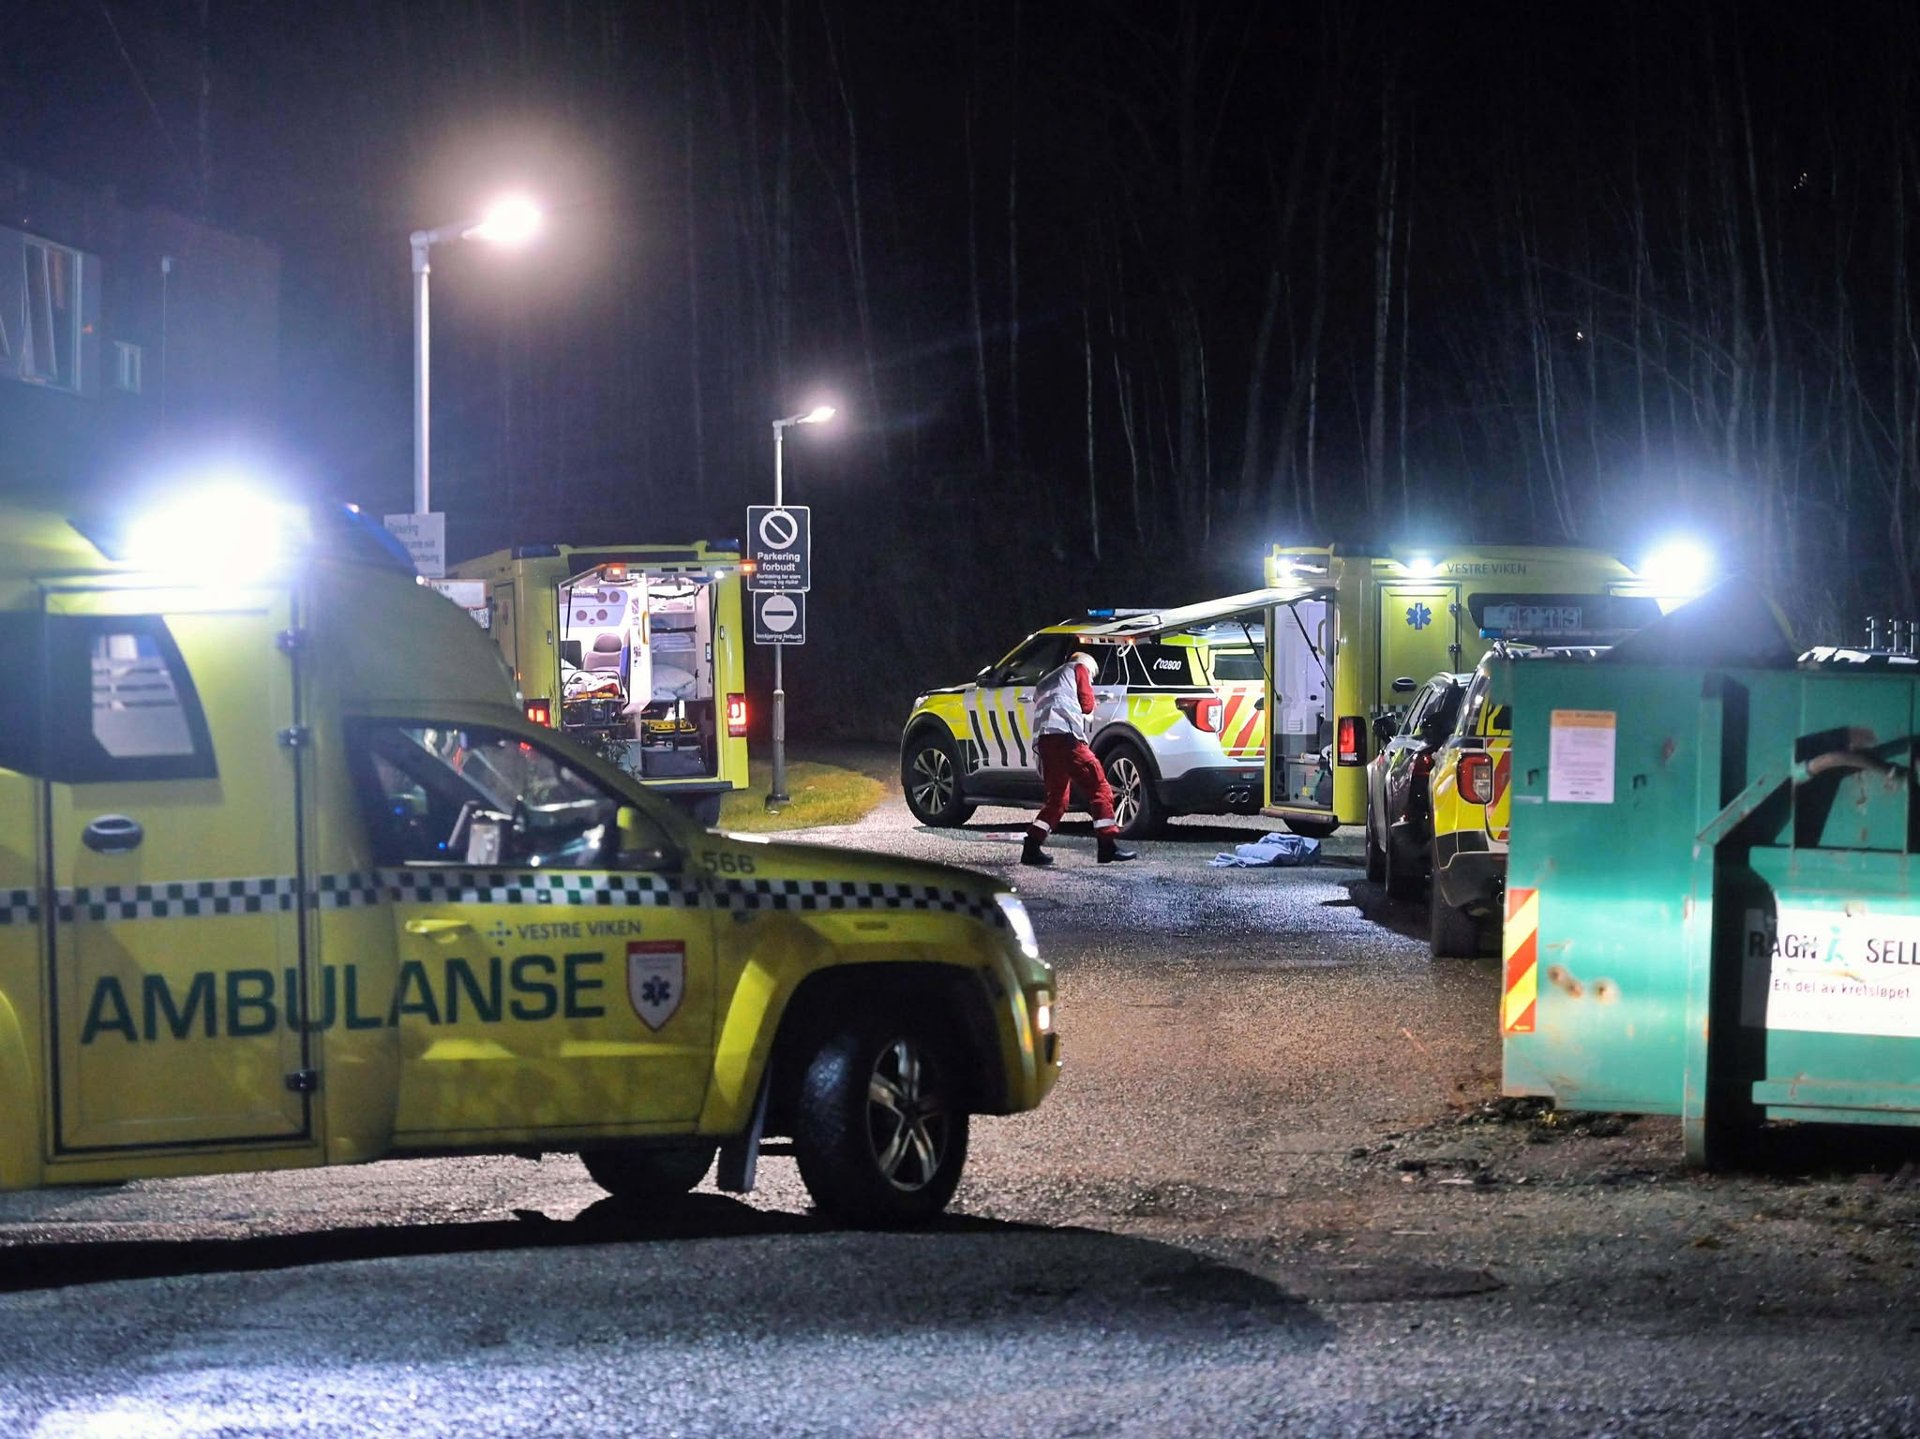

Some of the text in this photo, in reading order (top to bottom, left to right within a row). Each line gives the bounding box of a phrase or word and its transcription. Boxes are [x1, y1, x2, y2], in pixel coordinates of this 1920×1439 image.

[757, 552, 800, 562] Parkering
[762, 562, 796, 571] forbudt
[1448, 563, 1527, 574] VESTRE VIKEN
[1159, 660, 1182, 670] 02800
[702, 851, 756, 874] 566
[517, 919, 642, 940] VESTRE VIKEN
[1773, 978, 1911, 1000] En del av kretsløpet
[80, 951, 605, 1045] AMBULANSE
